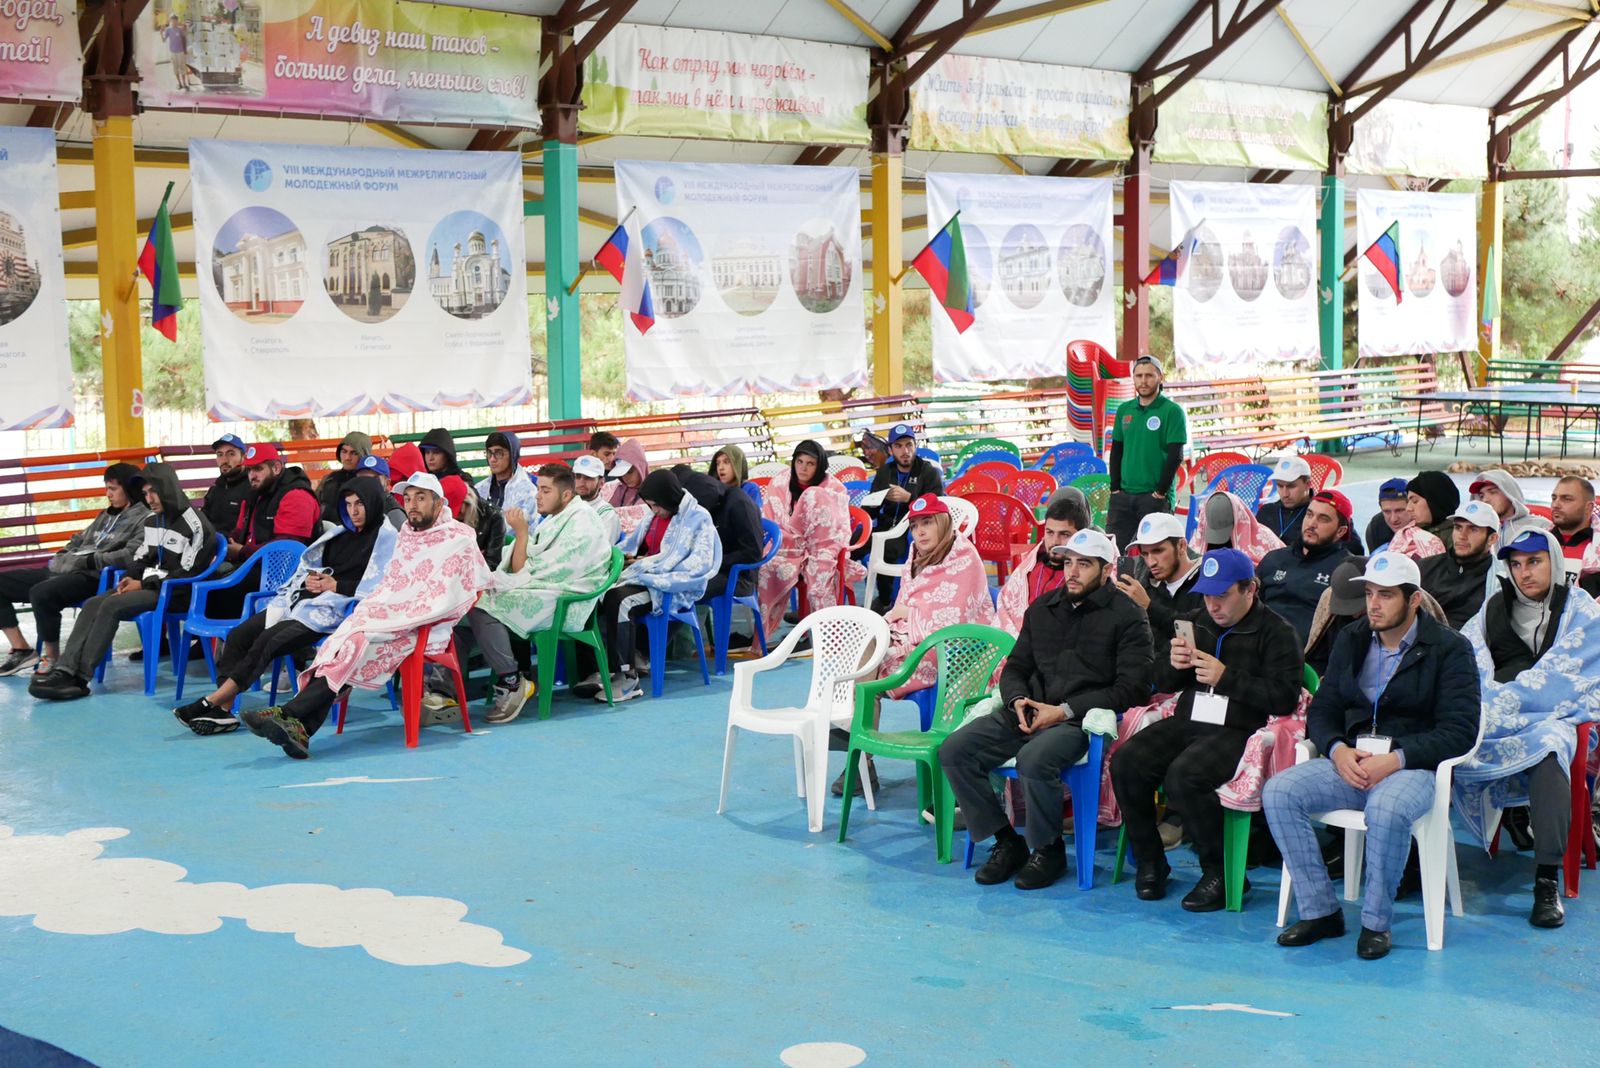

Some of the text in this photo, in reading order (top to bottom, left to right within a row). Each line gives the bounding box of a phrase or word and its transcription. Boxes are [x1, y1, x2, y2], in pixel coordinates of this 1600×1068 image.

[305, 15, 324, 41] А
[327, 21, 381, 56] девиз
[384, 30, 427, 51] наш
[431, 32, 487, 56] таков
[274, 54, 529, 98] больше дела, меньше слов!
[639, 47, 669, 72] Как
[672, 57, 720, 83] отряд
[283, 165, 488, 182] VIII МЕЖДУНАРОДНЫЙ МЕЖРЕЛИГИОЗНЫЙ
[284, 178, 399, 192] МОЛОДЕЖНЫЙ ФОРУМ
